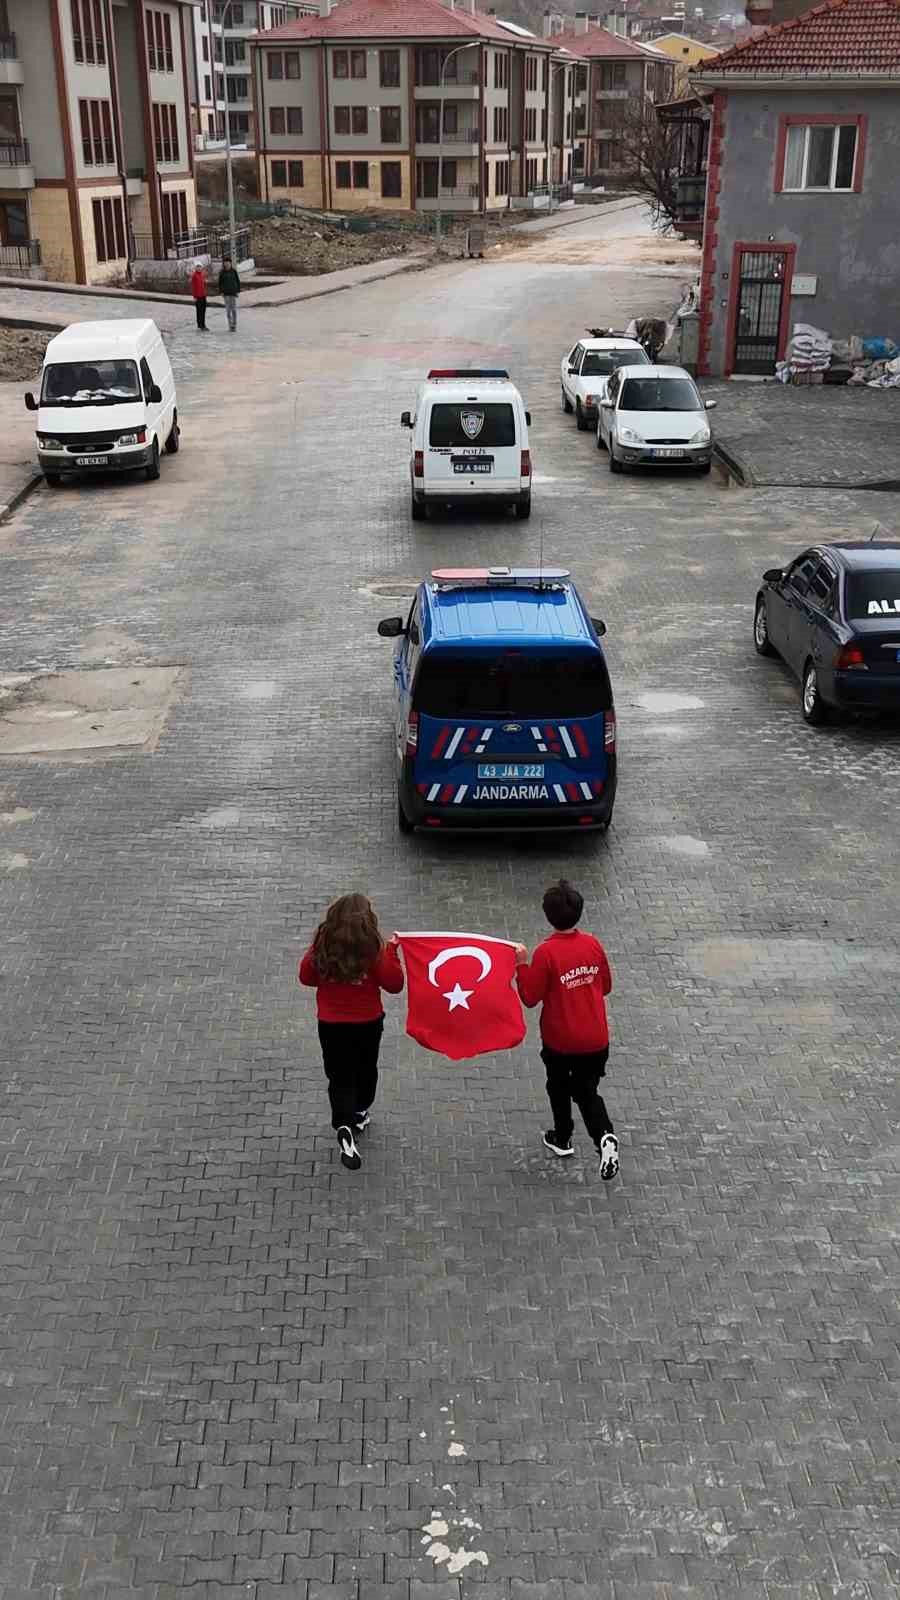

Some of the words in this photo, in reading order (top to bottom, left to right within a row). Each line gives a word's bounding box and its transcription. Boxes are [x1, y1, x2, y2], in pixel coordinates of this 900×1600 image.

[483, 765, 496, 777] 43
[502, 765, 519, 777] JAA
[524, 765, 542, 777] 222
[472, 785, 549, 800] JANDARMA
